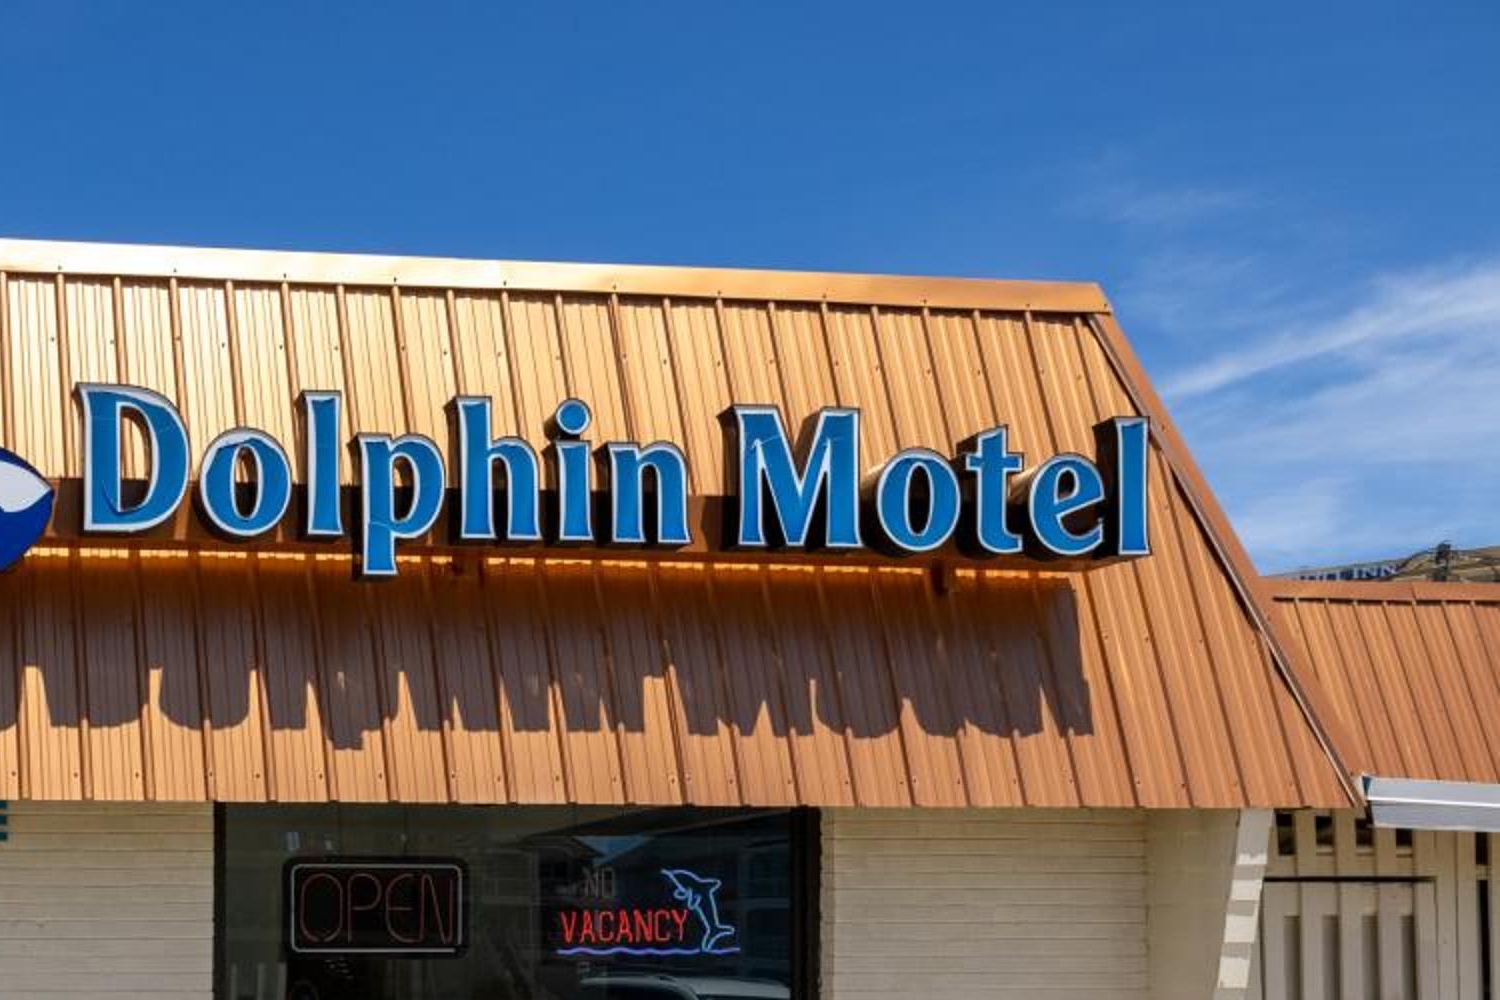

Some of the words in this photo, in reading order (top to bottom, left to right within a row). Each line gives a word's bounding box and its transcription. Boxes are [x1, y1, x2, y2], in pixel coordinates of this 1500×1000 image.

[74, 382, 693, 577] Dolphin
[728, 406, 1152, 561] Motel
[299, 872, 455, 945] OPEN
[581, 866, 616, 898] NO
[559, 908, 689, 945] VACANCY
